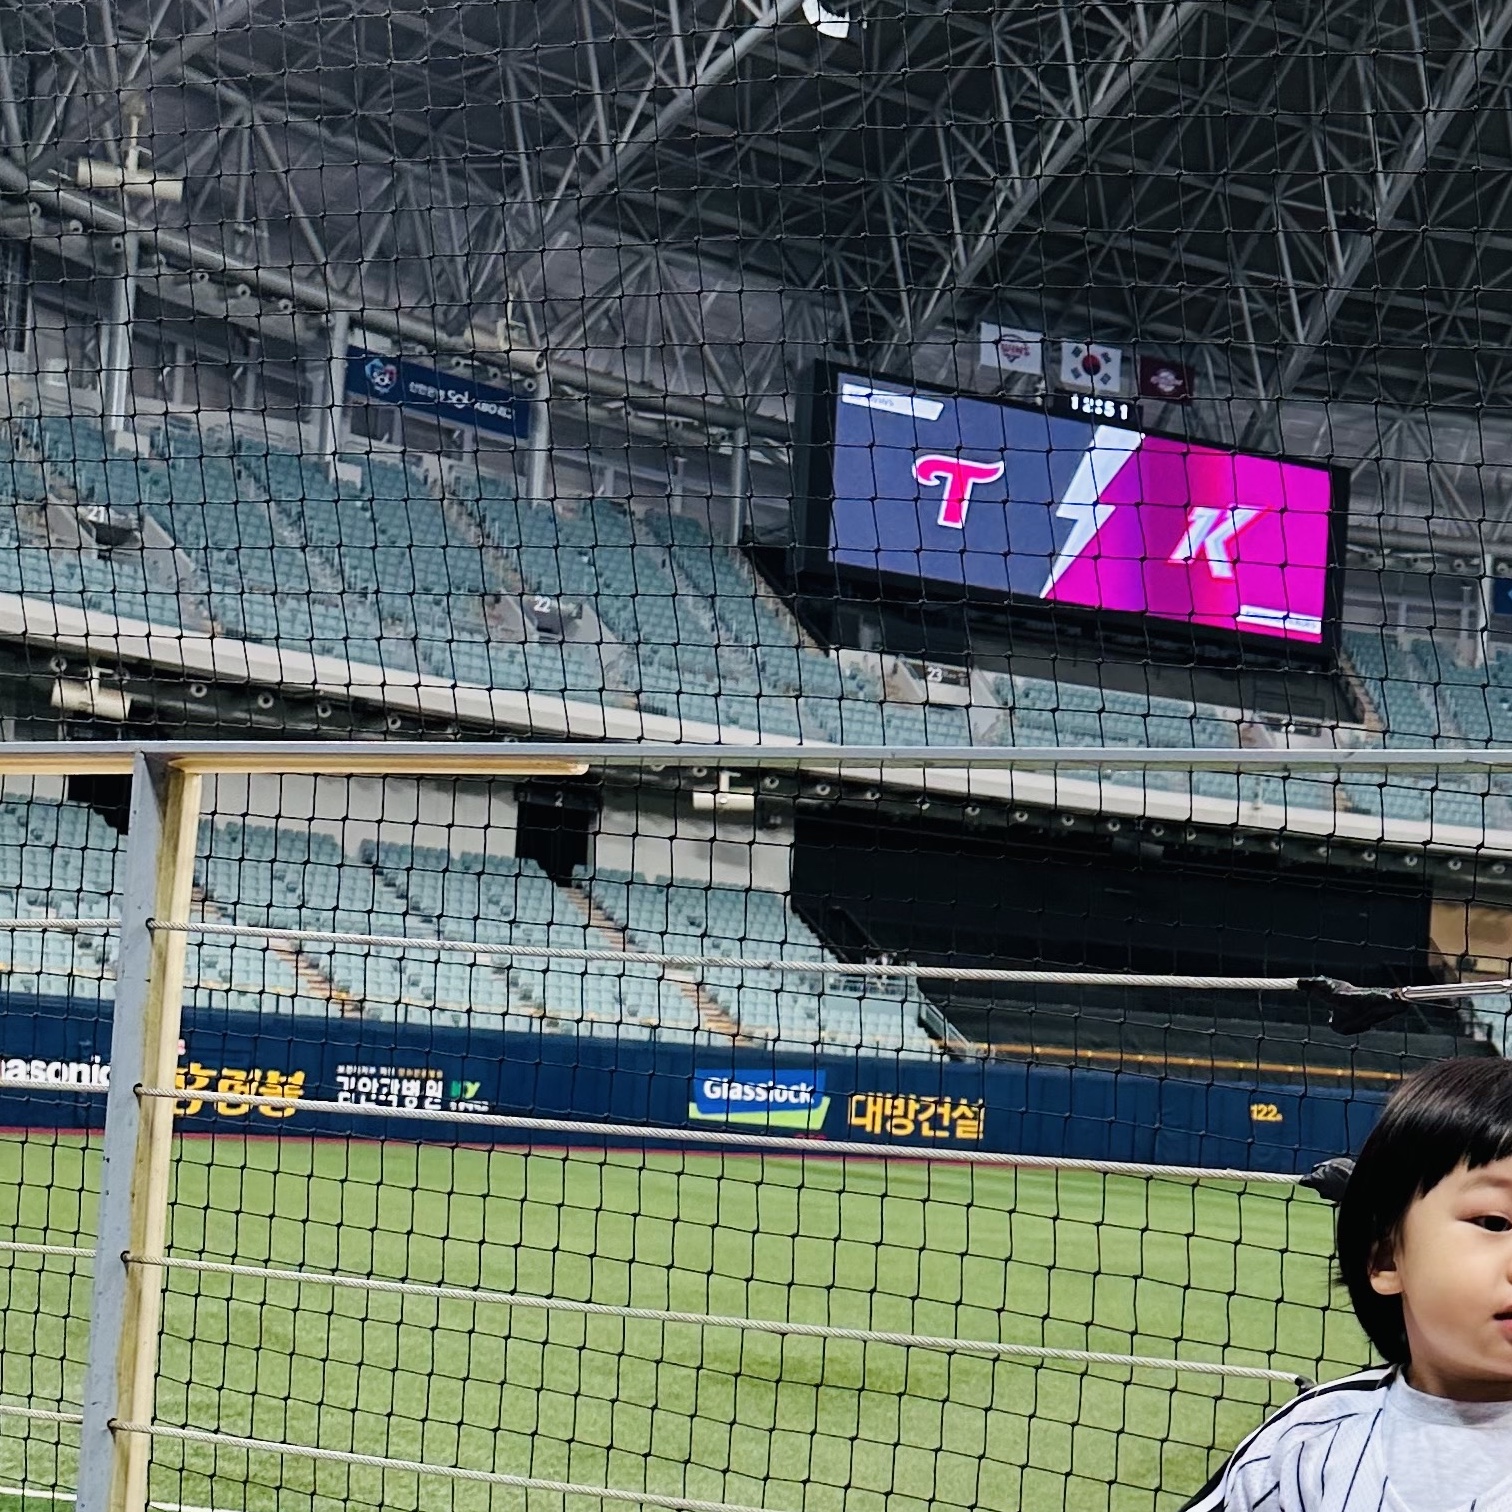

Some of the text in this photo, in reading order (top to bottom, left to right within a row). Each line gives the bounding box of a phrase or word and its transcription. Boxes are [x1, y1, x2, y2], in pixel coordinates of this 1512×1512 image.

[912, 454, 1004, 529] T
[1168, 503, 1270, 580] K
[0, 1055, 110, 1085] asonic
[703, 1076, 815, 1104] Glasslock
[849, 1092, 985, 1140] 대방건설
